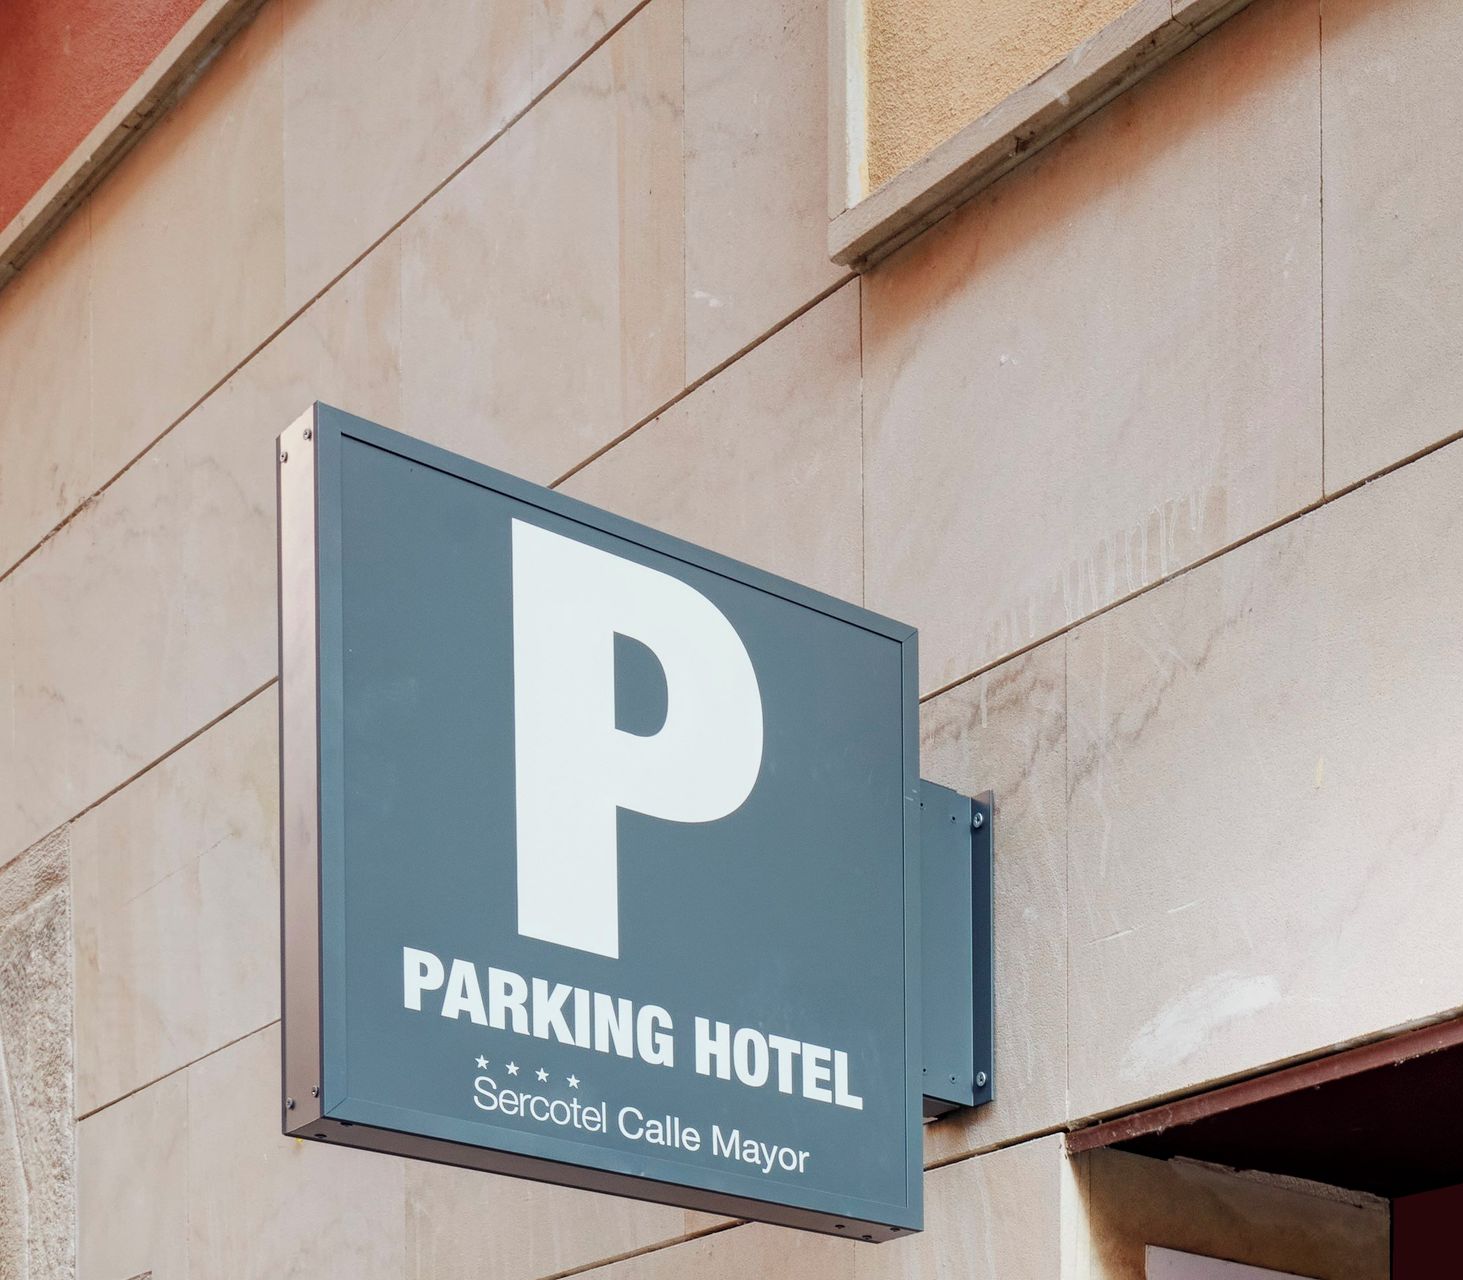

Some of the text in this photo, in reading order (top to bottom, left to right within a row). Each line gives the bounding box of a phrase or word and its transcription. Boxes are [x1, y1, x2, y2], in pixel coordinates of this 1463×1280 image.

[512, 517, 764, 960] P
[403, 945, 864, 1112] PARKING HOTEL
[473, 1075, 810, 1174] Sercotel Calle Mayor
